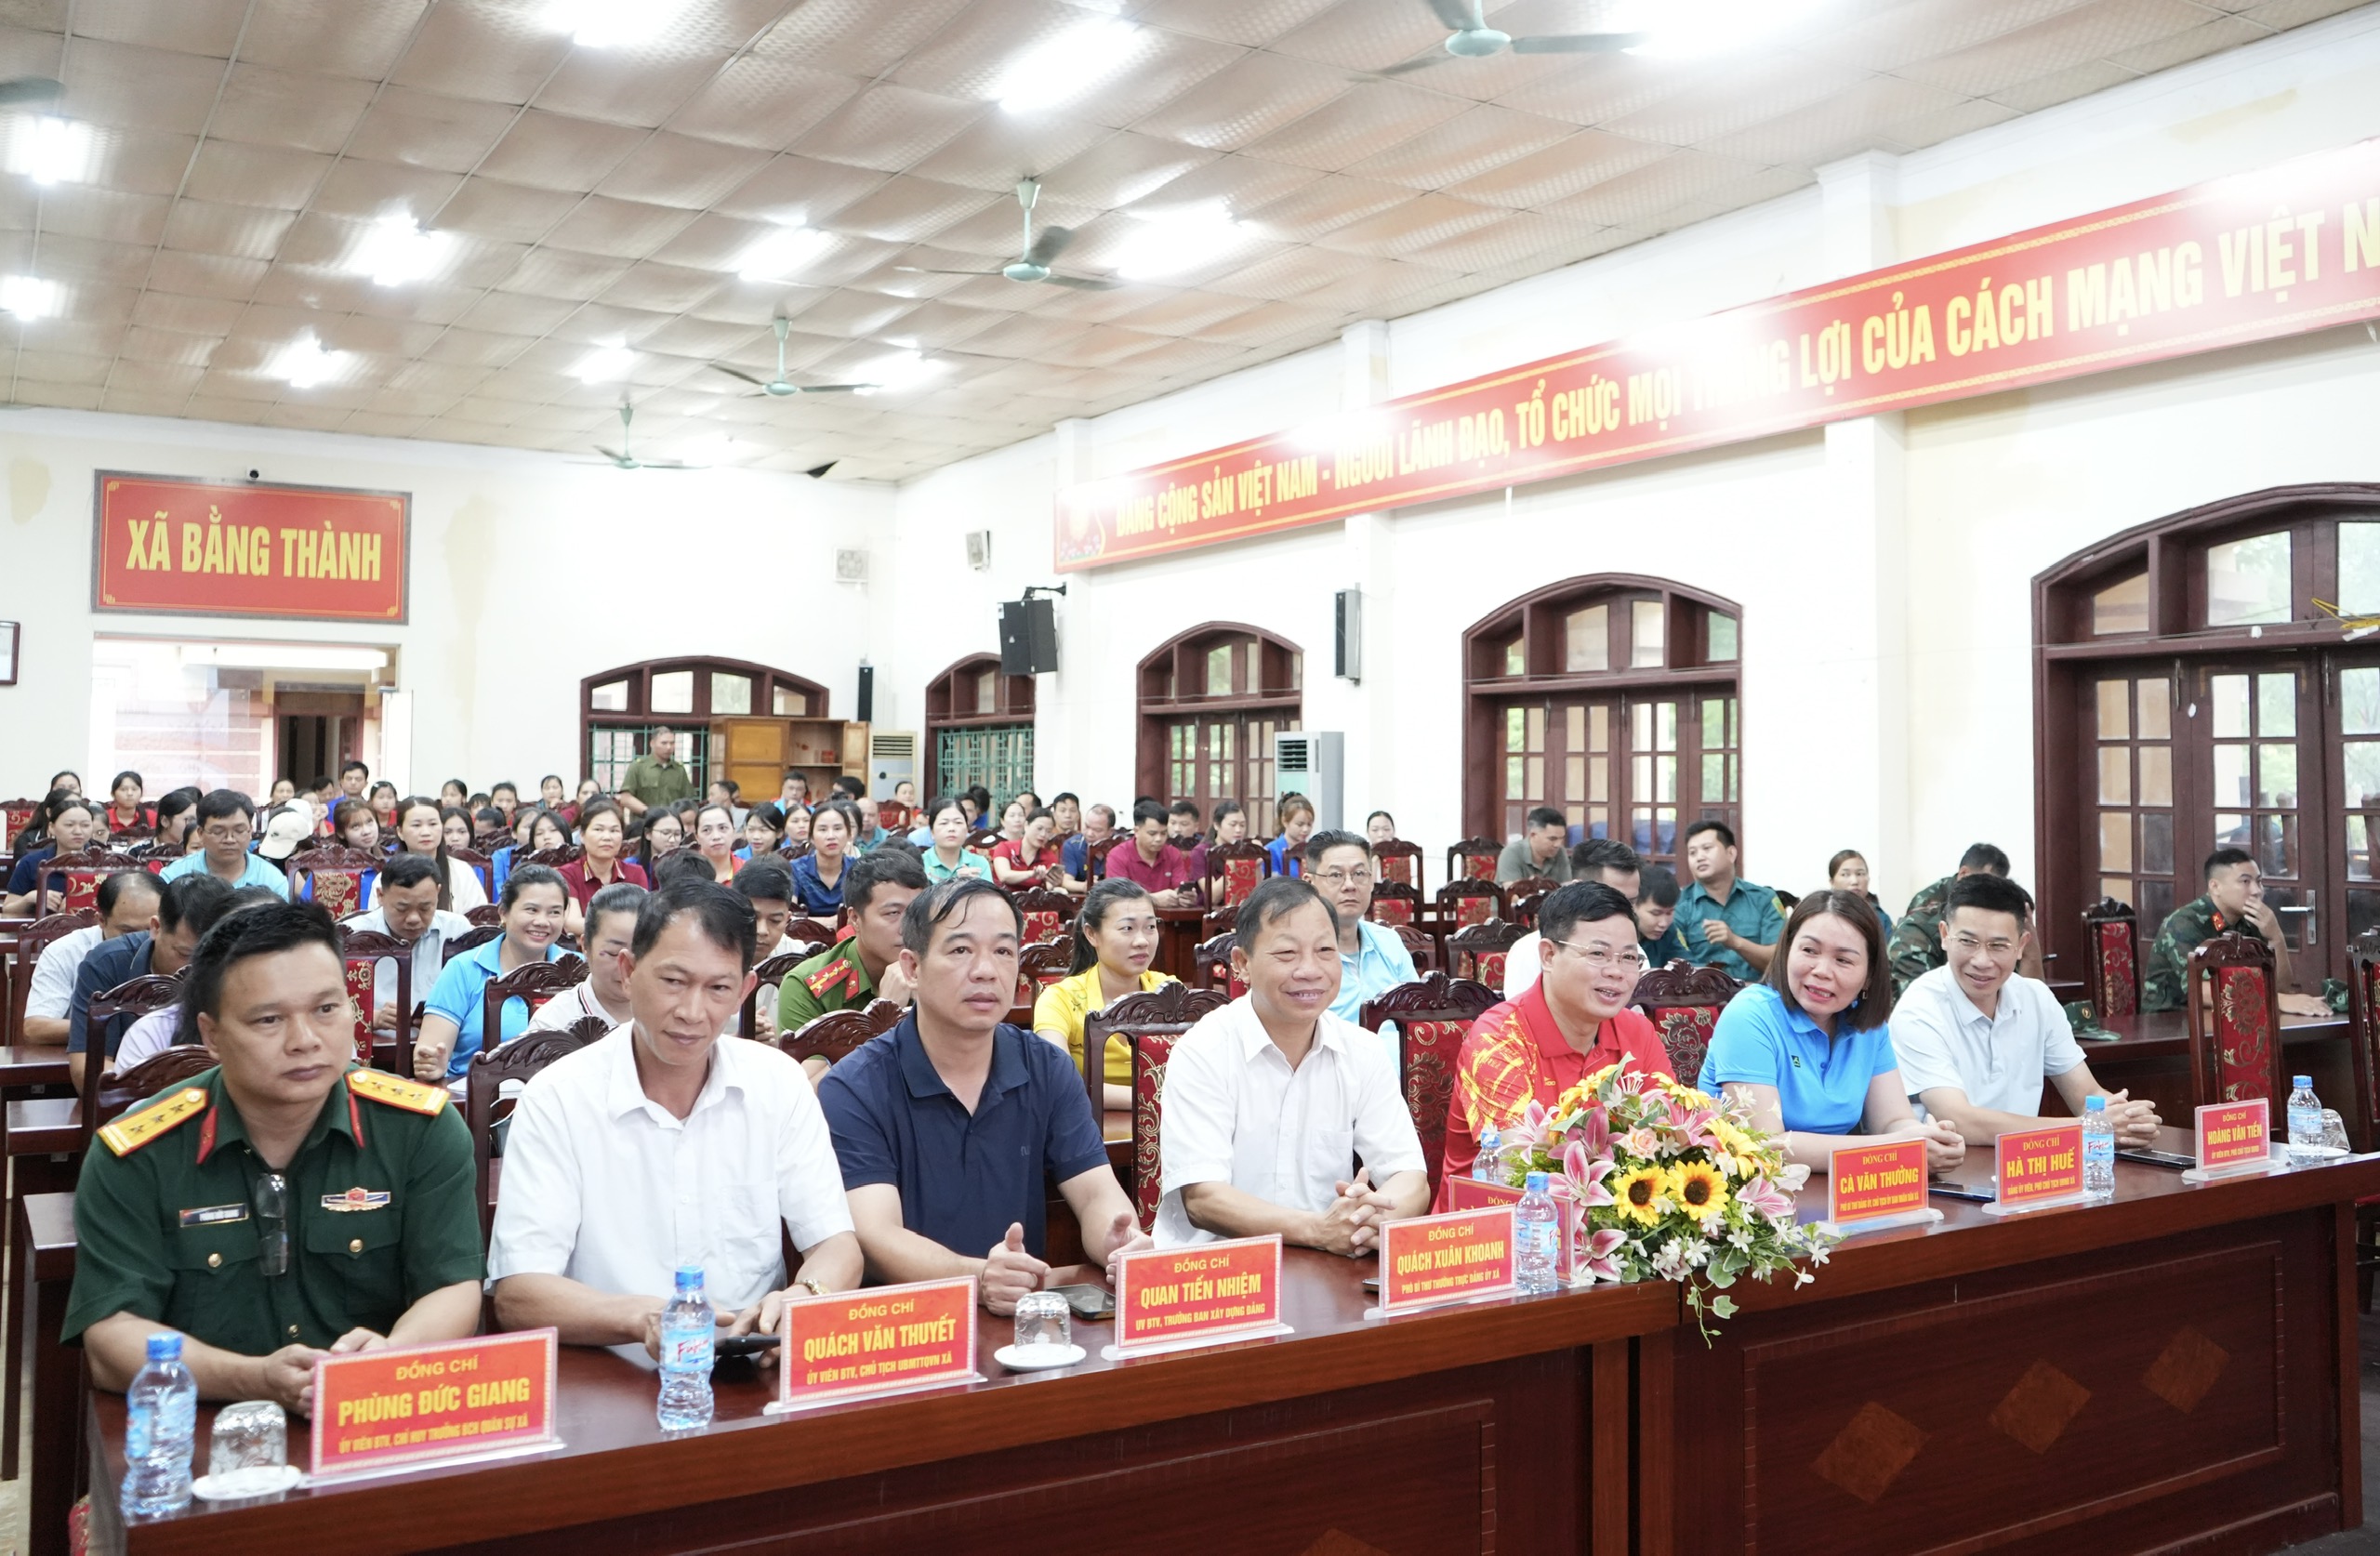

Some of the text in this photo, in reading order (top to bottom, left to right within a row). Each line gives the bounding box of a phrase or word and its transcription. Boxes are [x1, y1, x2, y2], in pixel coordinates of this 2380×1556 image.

[1157, 481, 1198, 534] CỘNG
[1201, 465, 1235, 520] SẢN
[1237, 459, 1273, 516] VIỆT
[1276, 454, 1317, 503] NAM
[1398, 419, 1453, 476] LÃNH
[1459, 408, 1511, 468] ĐẠO,
[1515, 378, 1546, 449] TỔ
[1552, 374, 1620, 442] CHỨC
[1628, 366, 1682, 431] MỌI
[1800, 319, 1852, 396] LỢI
[1862, 291, 1937, 375] CỦA
[1946, 276, 2054, 358] CÁCH
[2067, 240, 2204, 336] MẠNG
[2217, 204, 2326, 304] VIỆT
[126, 504, 381, 581] XÃ BẰNG THÀNH
[2238, 1110, 2246, 1120] CHÍ
[2046, 1134, 2060, 1147] CHÍ
[2207, 1127, 2231, 1146] HOÀNG
[2232, 1125, 2246, 1141] VĂN
[1884, 1150, 1897, 1163] CHÍ
[2006, 1146, 2075, 1178] HÀ THỊ HUẾ
[1840, 1165, 1919, 1194] CÀ VĂN THƯỞNG
[1428, 1221, 1474, 1242] ĐỒNG CHÍ
[1174, 1254, 1230, 1273] ĐỒNG CHÍ
[1397, 1241, 1504, 1276] QUÁCH XUÂN KHOANH
[1141, 1272, 1262, 1310] QUAN TIẾN NHIỆM
[848, 1299, 914, 1321] ĐỒNG CHÍ
[1147, 1317, 1163, 1330] BTV,
[1164, 1311, 1193, 1326] TRƯỞNG
[1194, 1311, 1210, 1323] BAN
[1210, 1307, 1224, 1320] XÂY
[1225, 1306, 1245, 1320] DỰNG
[1246, 1301, 1265, 1315] ĐẢNG
[804, 1312, 957, 1364] QUÁCH VĂN THUYẾT
[396, 1353, 479, 1381] ĐỒNG CHÍ
[806, 1351, 952, 1385] ỦY VIÊN BTV, CHỦ TỊCH UBMTTQVN XÃ
[338, 1377, 530, 1427] PHÙNG ĐỨC GIANG
